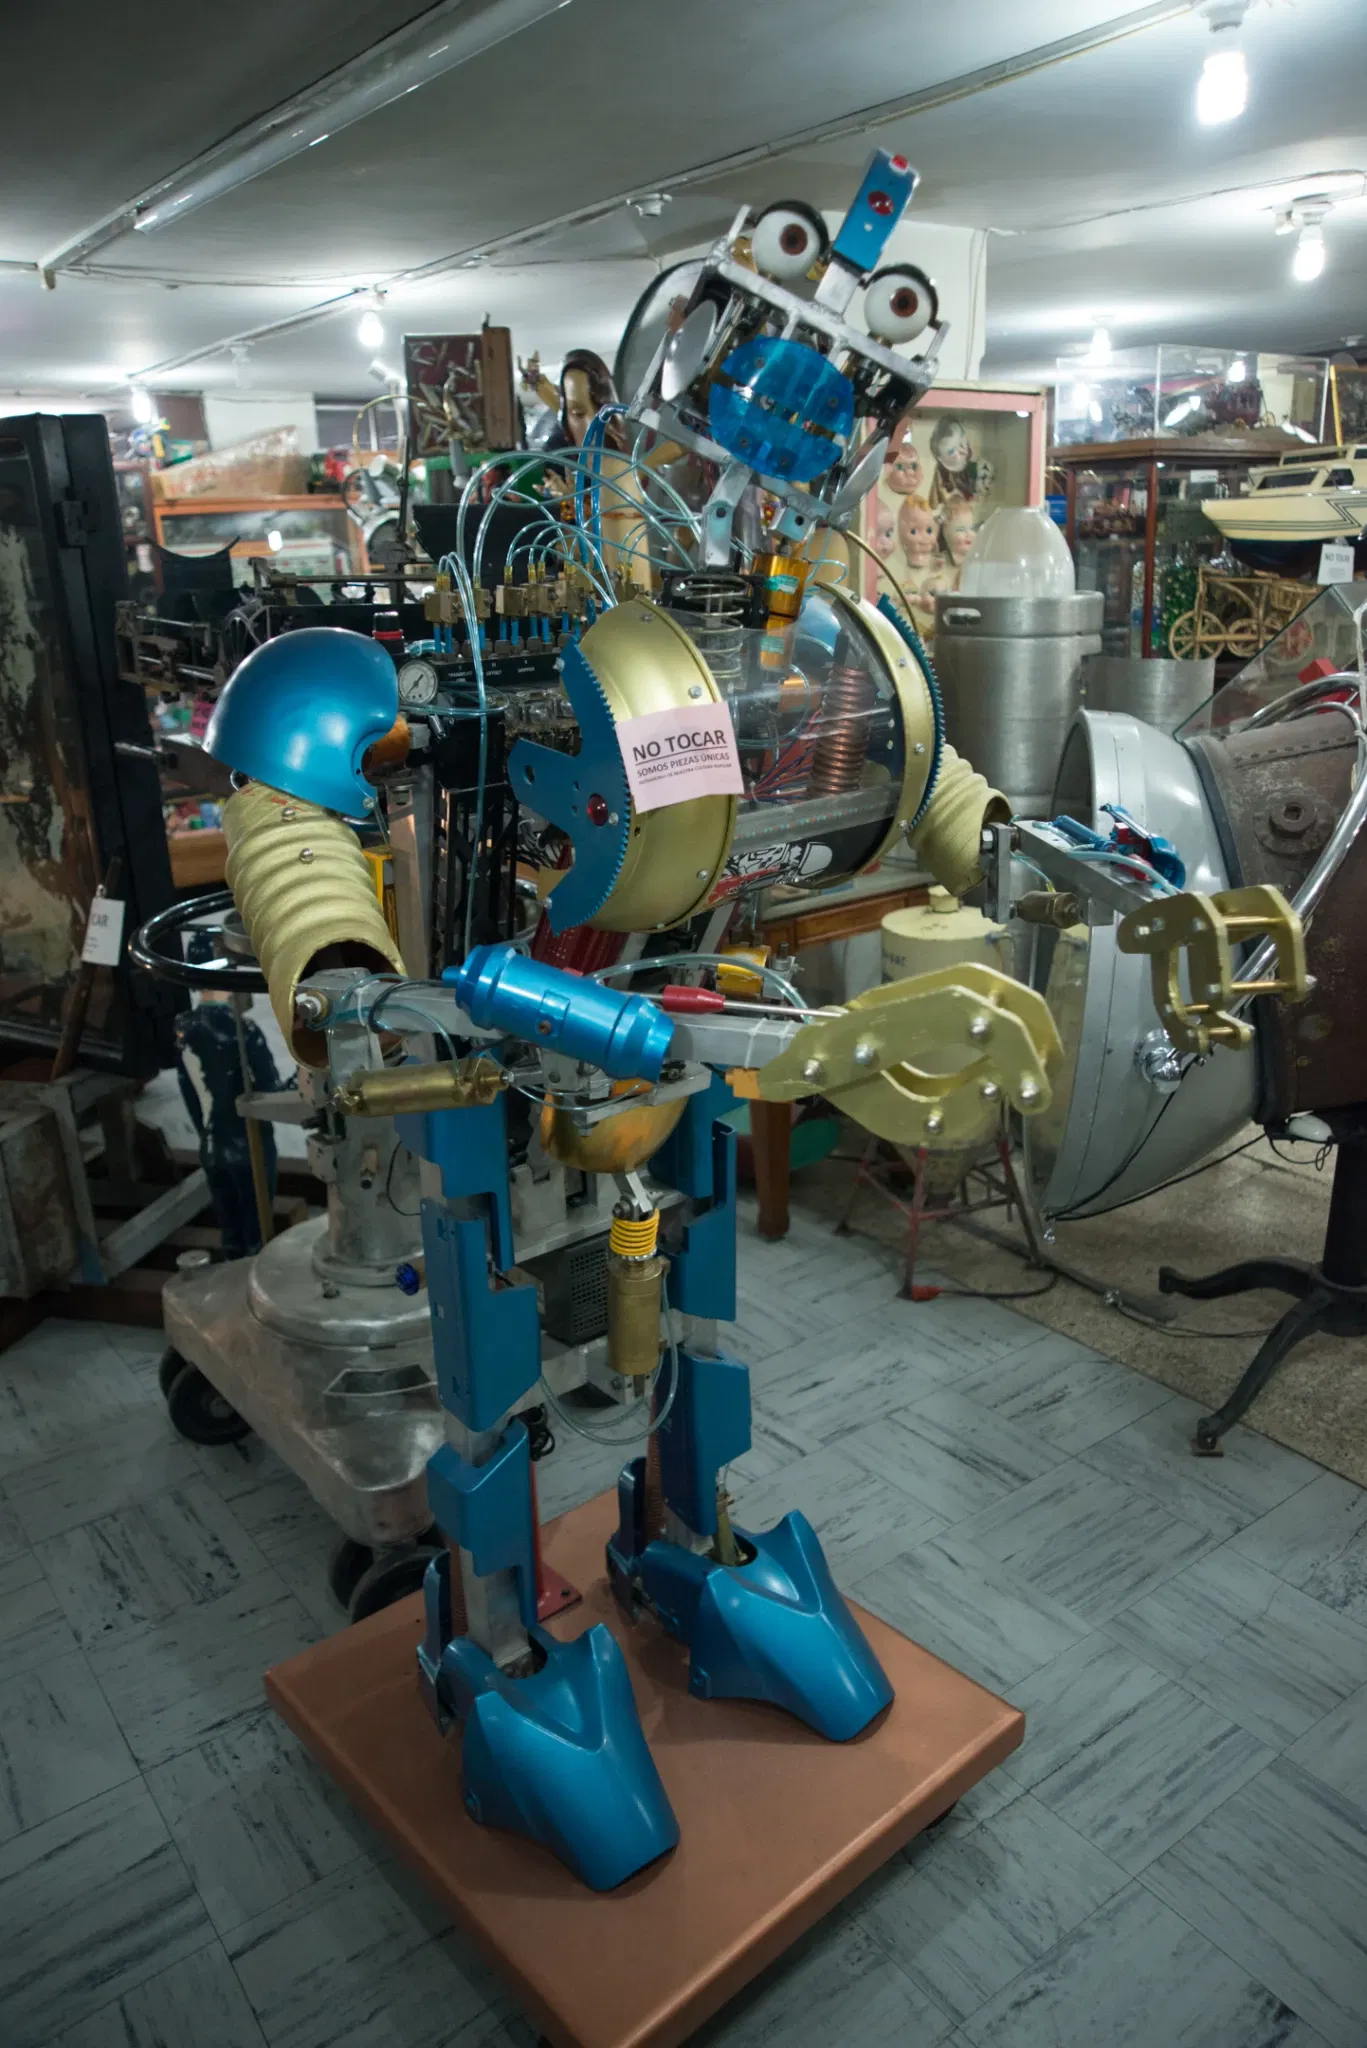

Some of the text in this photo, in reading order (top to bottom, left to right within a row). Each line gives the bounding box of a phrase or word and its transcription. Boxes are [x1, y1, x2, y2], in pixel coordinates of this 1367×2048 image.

[632, 730, 727, 761] NO TOCAR
[637, 752, 730, 777] SOMOS PIEZAS ÚNICAS
[674, 767, 694, 776] NUESTRA
[92, 914, 109, 927] CAR
